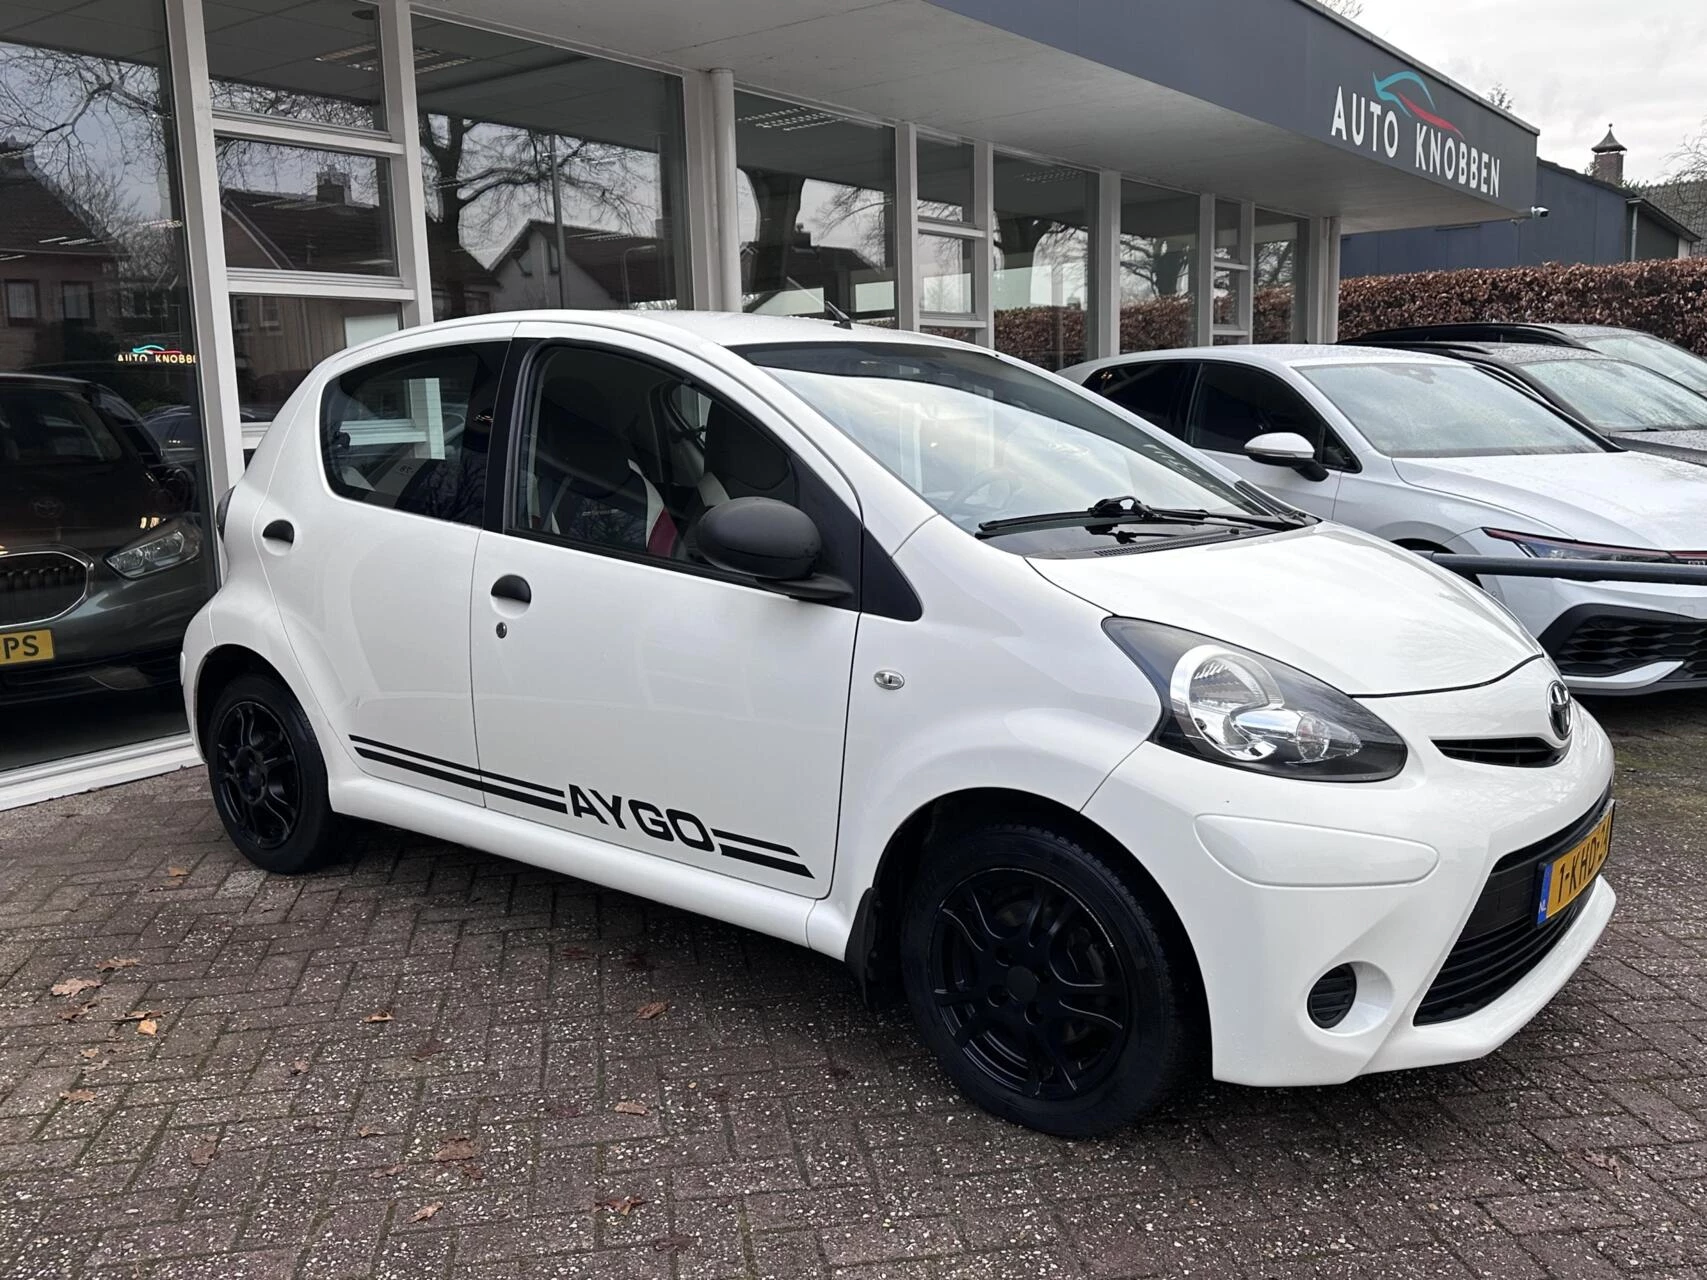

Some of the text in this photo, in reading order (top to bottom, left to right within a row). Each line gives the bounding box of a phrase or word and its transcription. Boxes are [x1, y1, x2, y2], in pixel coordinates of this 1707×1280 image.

[1331, 85, 1500, 198] AUTO KNOBBEN
[568, 784, 715, 852] AYGO
